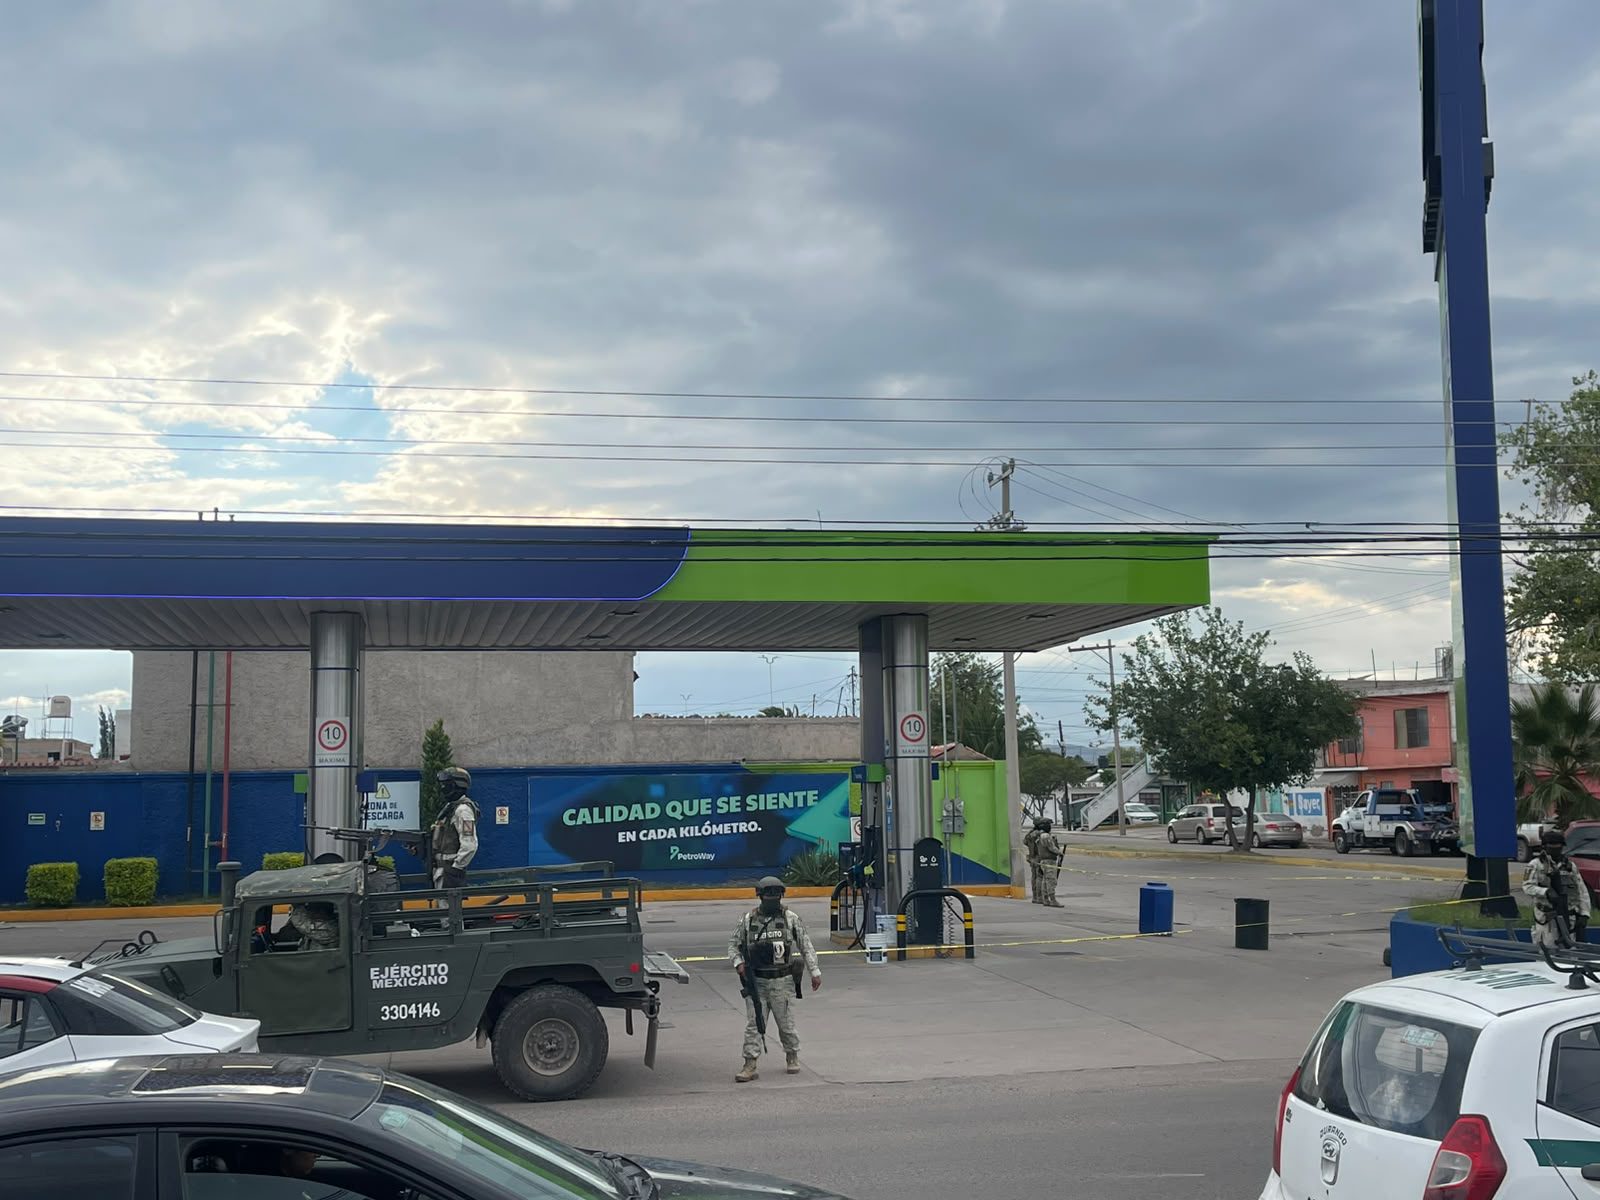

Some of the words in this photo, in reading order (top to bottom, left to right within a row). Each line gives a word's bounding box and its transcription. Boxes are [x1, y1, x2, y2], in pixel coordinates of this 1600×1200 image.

[324, 726, 341, 740] 10
[906, 720, 921, 733] 10
[562, 803, 661, 826] CALIDAD
[666, 798, 713, 821] QUE
[716, 795, 742, 814] SE
[745, 790, 819, 812] SIENTE
[365, 810, 404, 821] ESCARGA
[617, 830, 637, 843] EN
[639, 827, 677, 841] CADA
[680, 820, 762, 838] KILÓMETRO.
[677, 851, 715, 861] PetroWay
[754, 930, 783, 941] ECITO
[370, 963, 449, 980] EJÉRCITO
[372, 975, 448, 989] MEXICANO
[380, 1002, 440, 1020] 3304146
[1319, 1125, 1348, 1146] DURANGO
